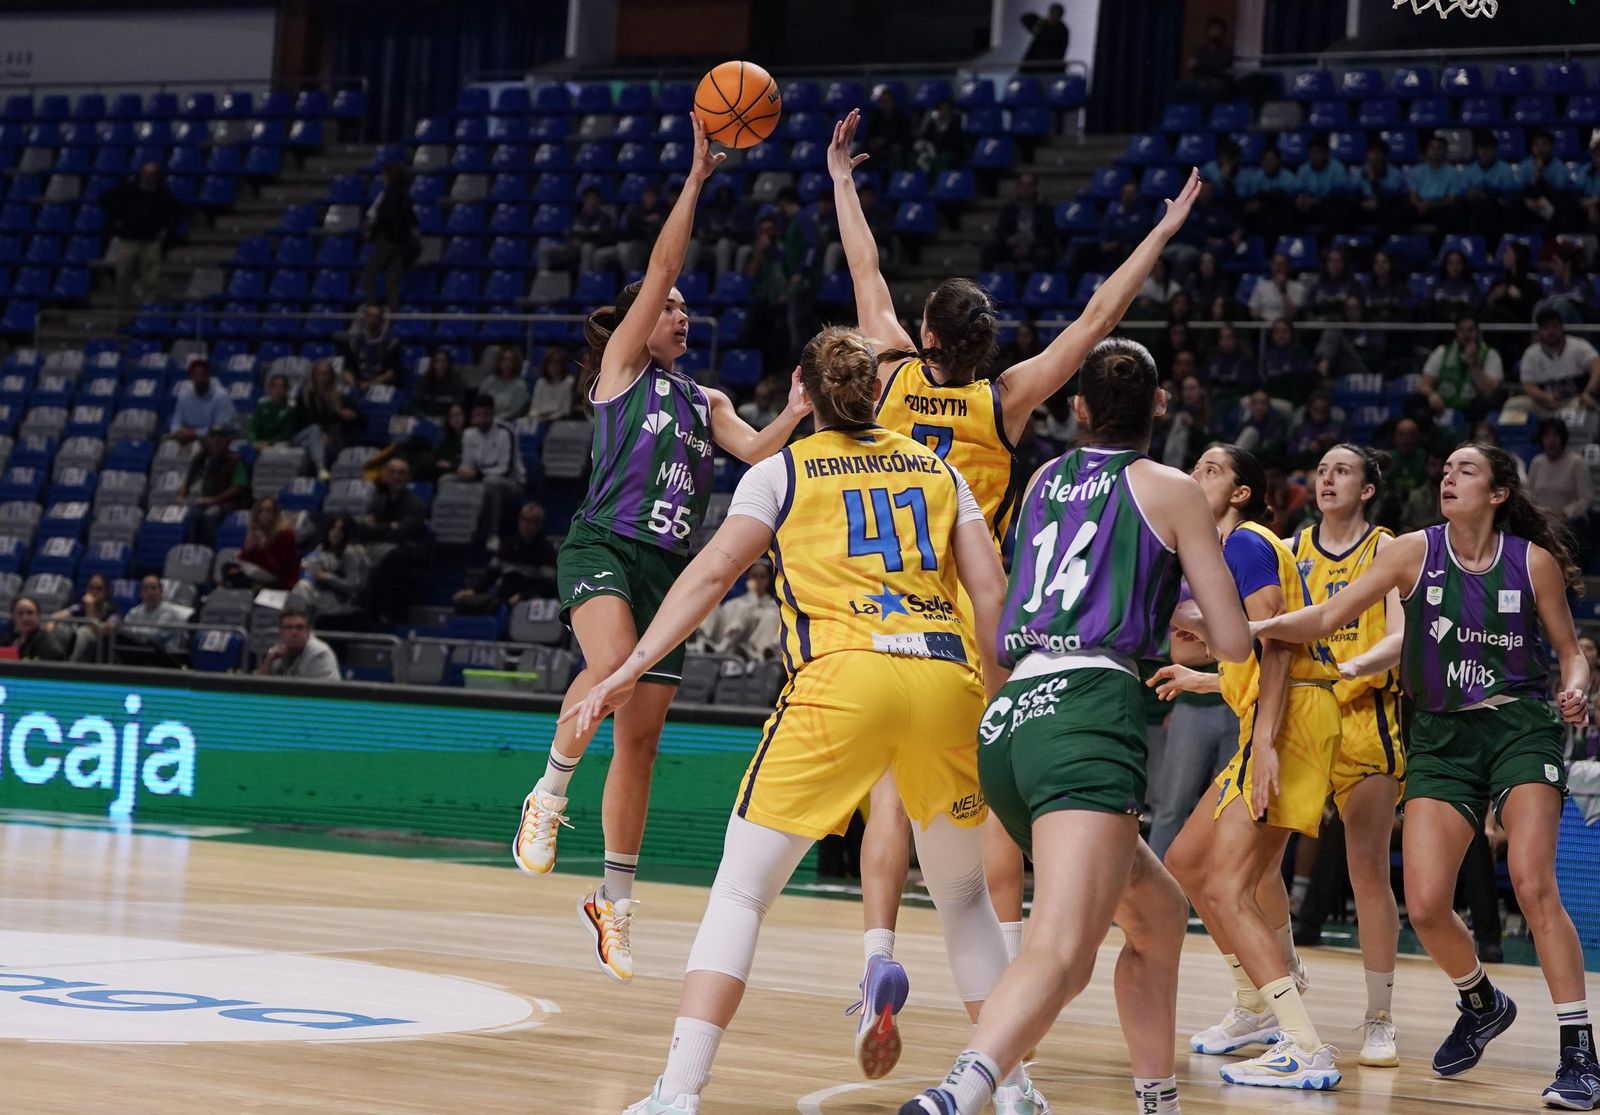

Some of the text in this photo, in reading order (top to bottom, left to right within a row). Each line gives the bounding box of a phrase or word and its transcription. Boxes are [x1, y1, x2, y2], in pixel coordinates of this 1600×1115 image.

[804, 450, 942, 478] HERNANGÓMEZ
[1040, 471, 1118, 503] Herlih
[648, 500, 691, 540] 55
[842, 487, 938, 573] 41
[1022, 520, 1098, 613] 14
[849, 600, 879, 615] La
[1456, 627, 1524, 651] Unicaja
[1446, 659, 1496, 693] Mijas
